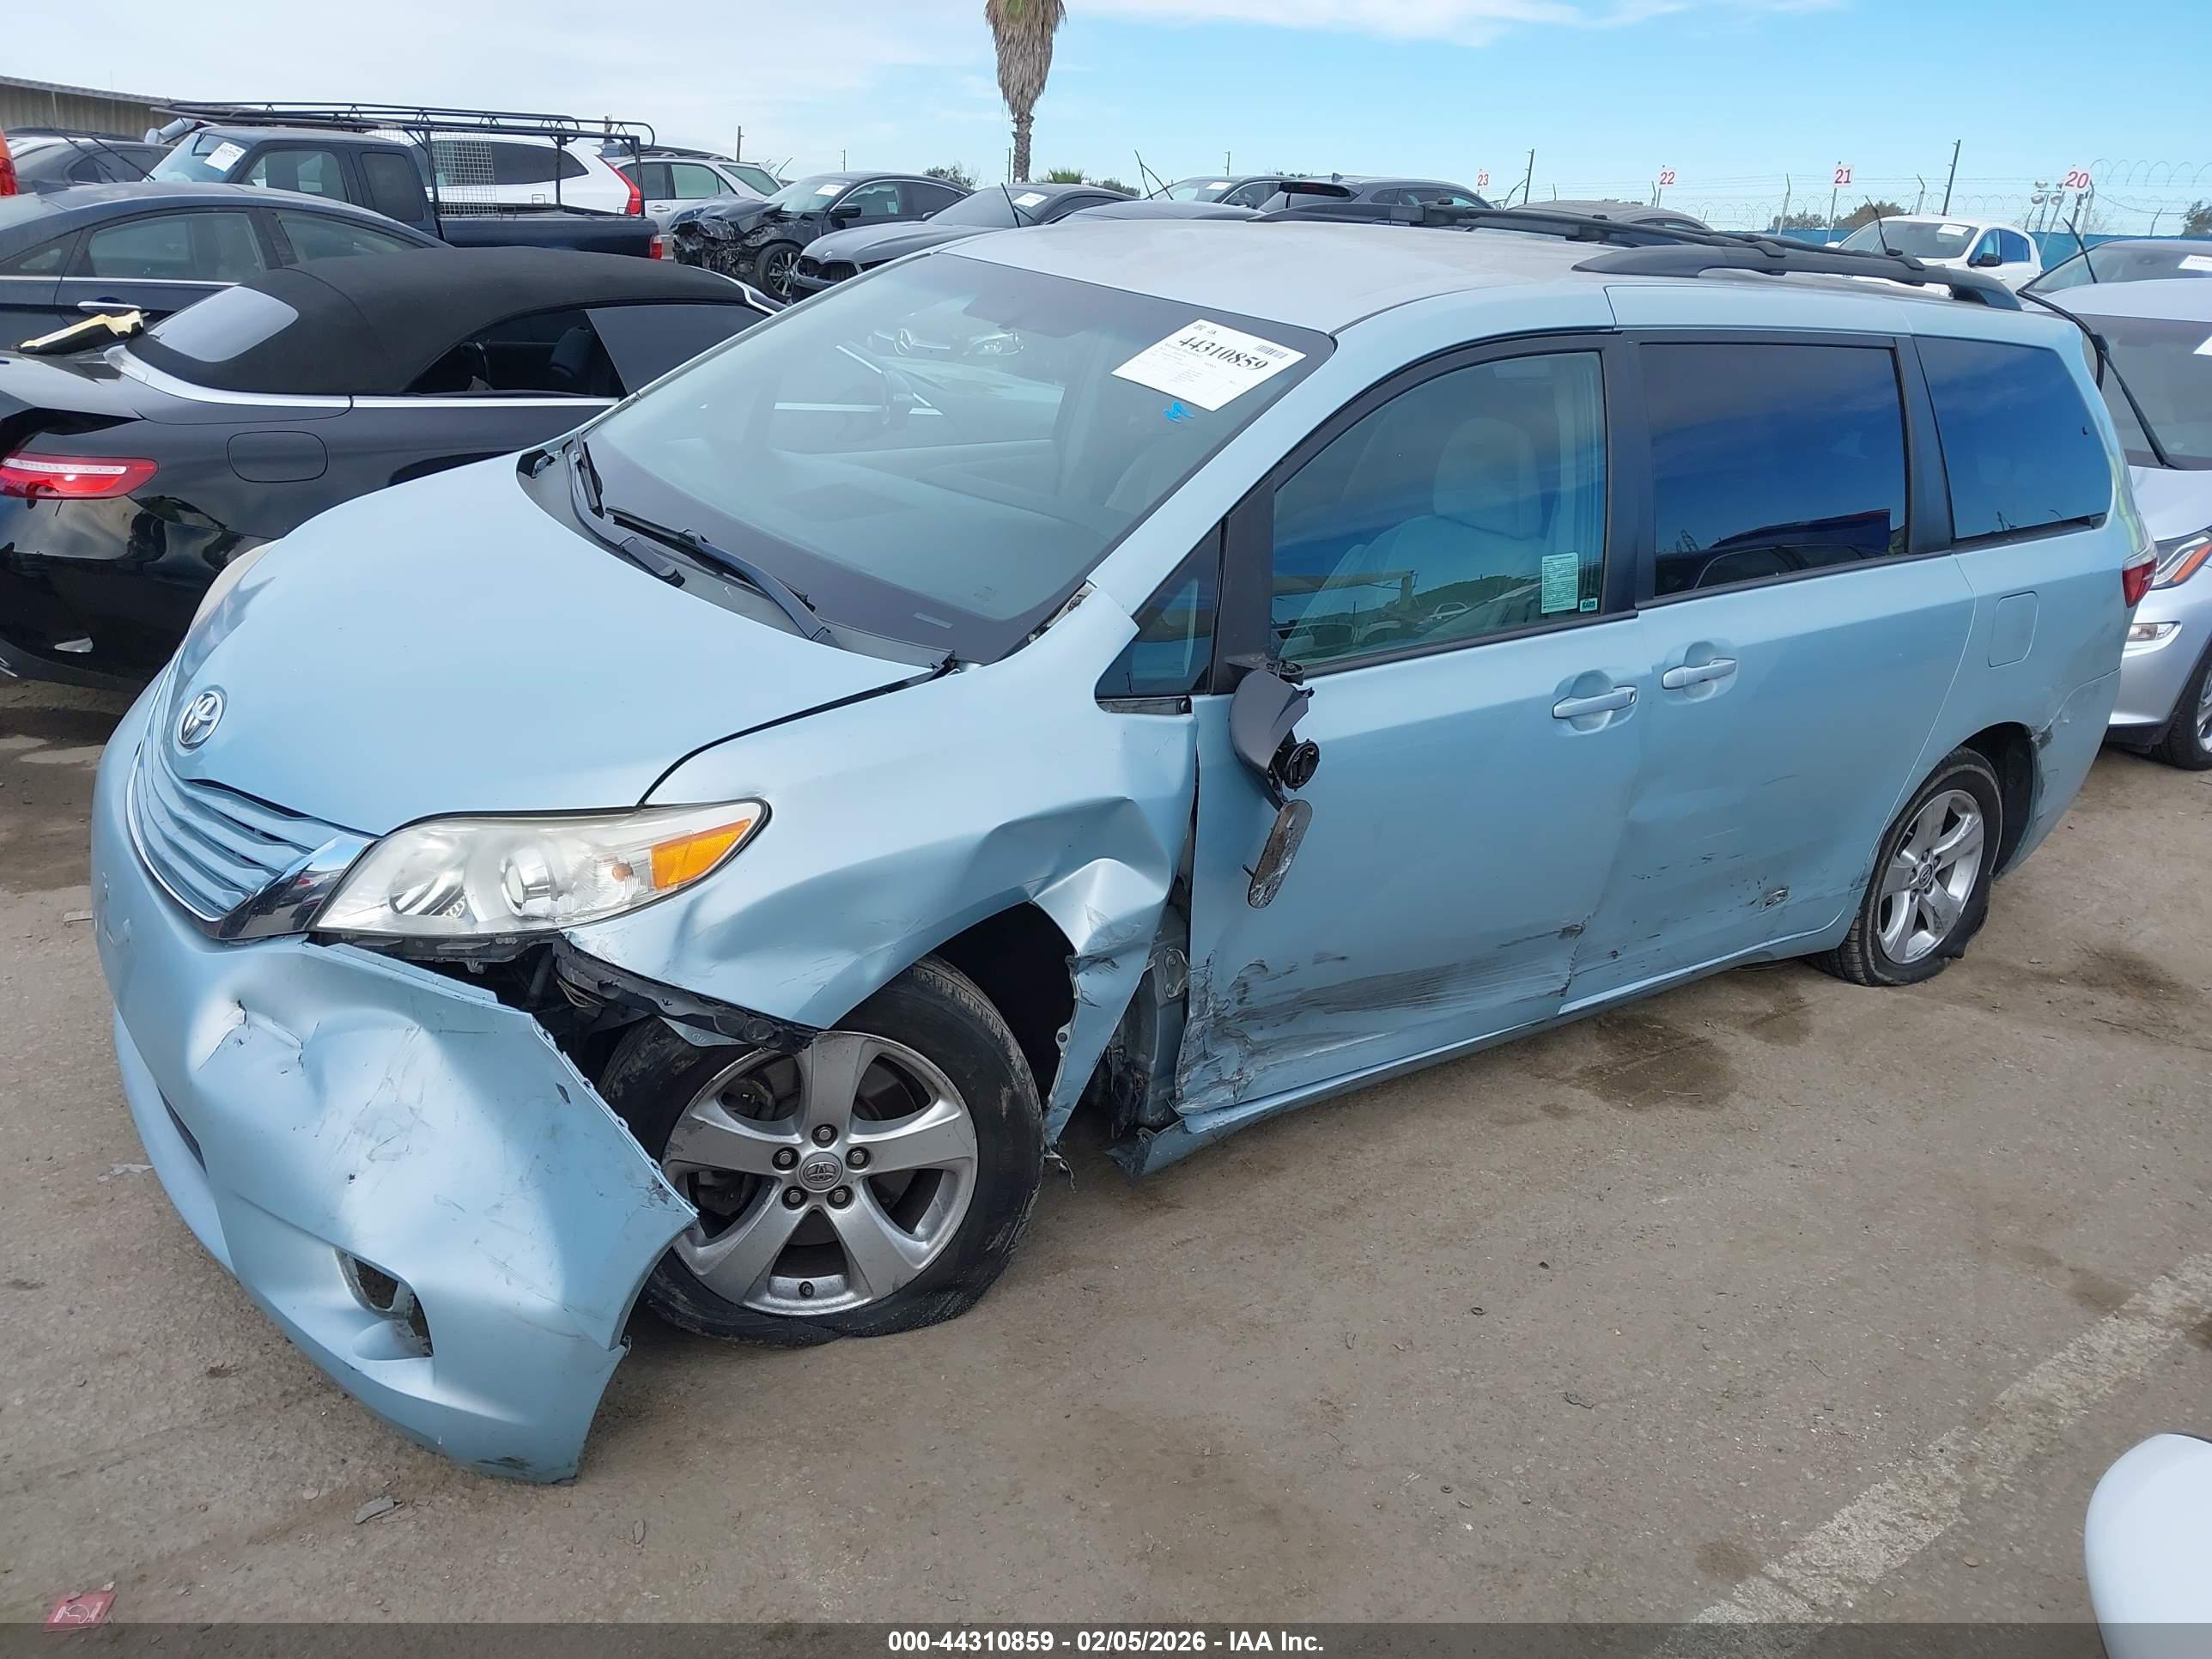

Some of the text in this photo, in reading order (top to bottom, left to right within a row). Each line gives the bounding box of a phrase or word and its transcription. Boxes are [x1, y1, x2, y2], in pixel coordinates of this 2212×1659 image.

[1477, 173, 1489, 186] 23
[1659, 171, 1675, 185] 22
[1834, 168, 1851, 184] 21
[2064, 171, 2089, 189] 20
[1178, 336, 1269, 371] 44310859
